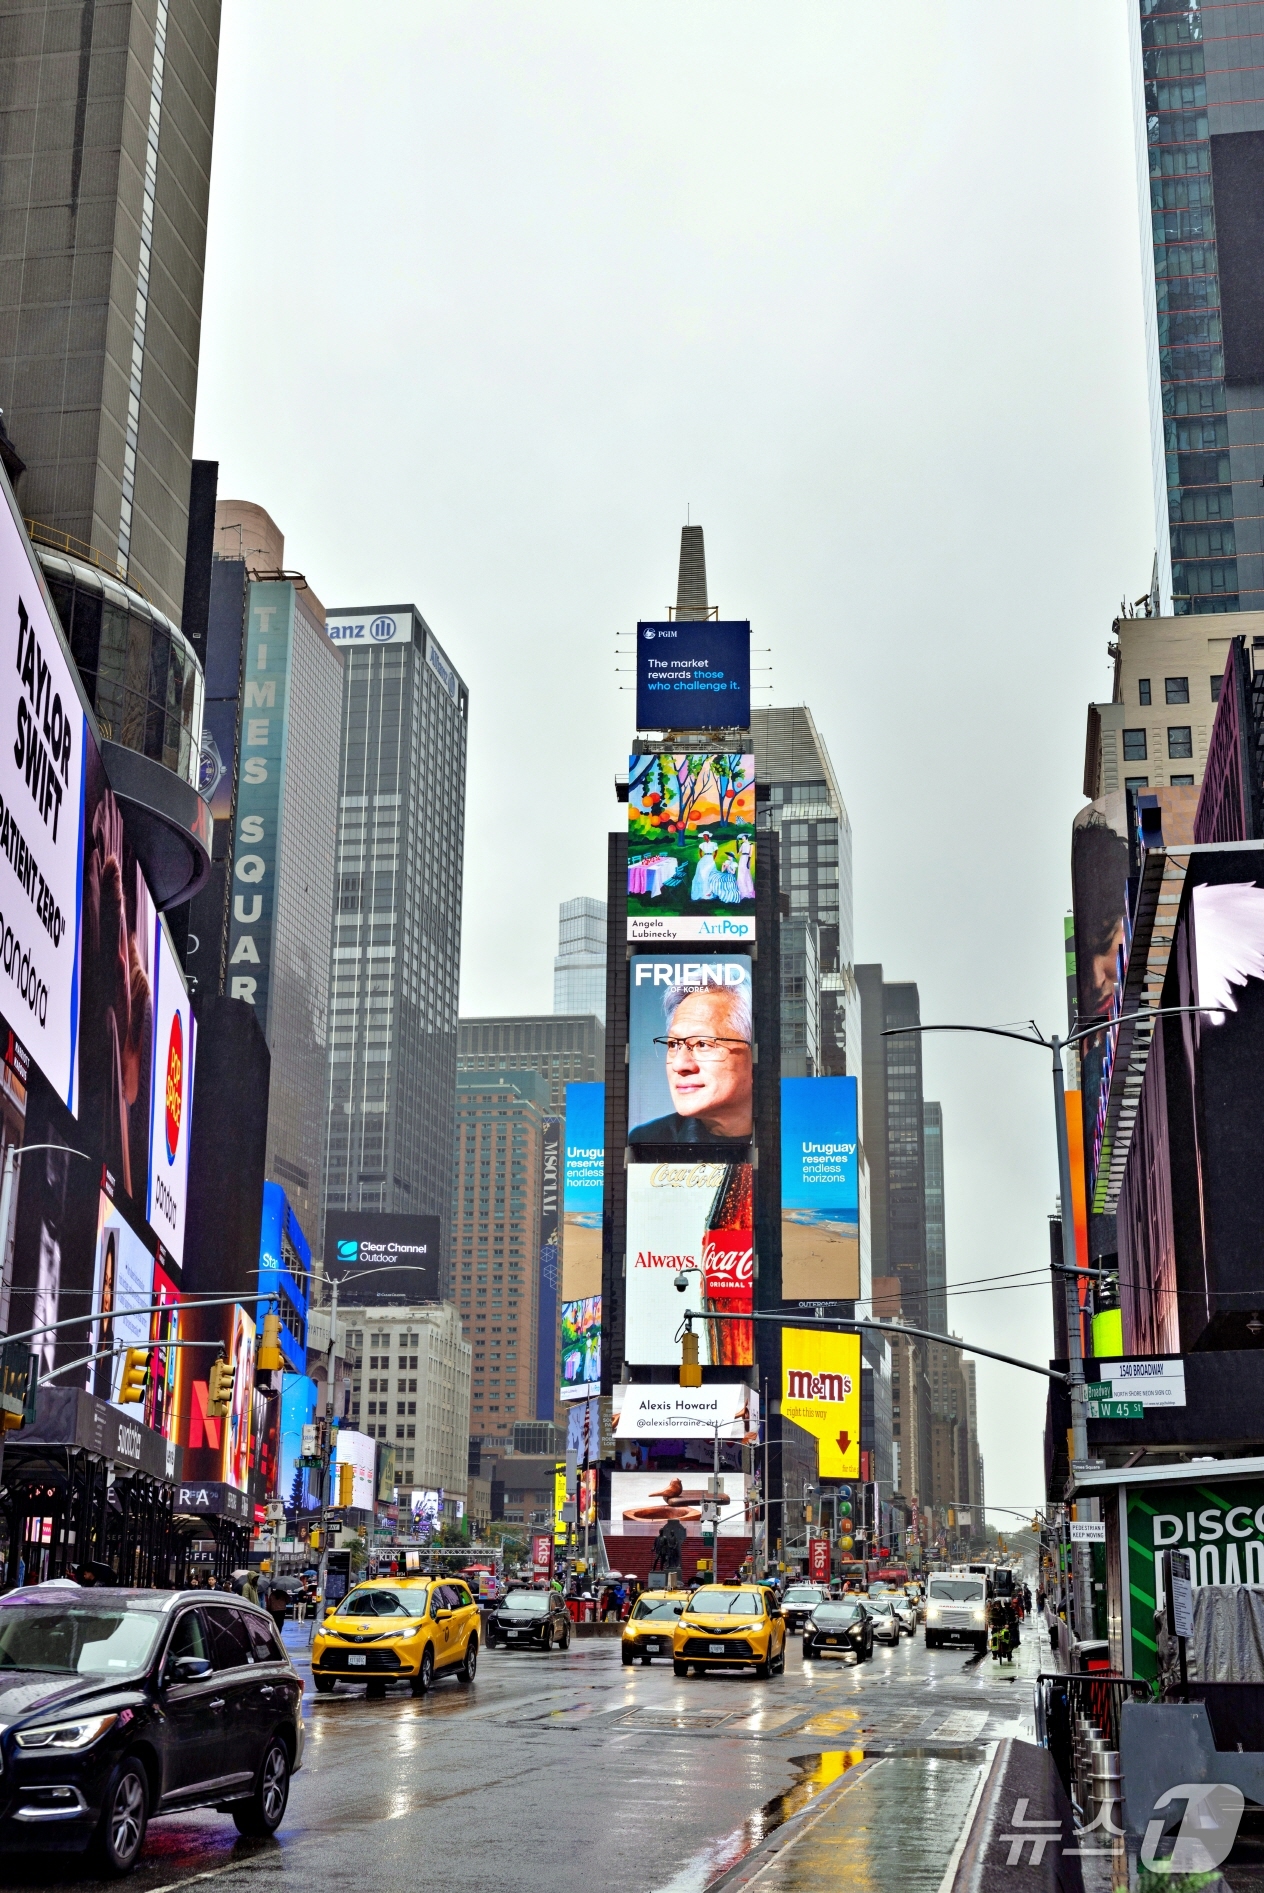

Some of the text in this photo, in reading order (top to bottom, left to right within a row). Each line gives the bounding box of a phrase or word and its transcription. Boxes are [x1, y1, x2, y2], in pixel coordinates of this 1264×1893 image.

[658, 630, 678, 638] PGIM
[648, 659, 709, 668] The market
[648, 670, 724, 679] rewards those
[16, 594, 72, 789] TAYLOR
[648, 681, 740, 692] who challenge it.
[243, 606, 276, 785] TIMES
[14, 695, 63, 845] SWIFT
[632, 919, 663, 929] Angela
[632, 930, 677, 940] Lubinecky
[635, 963, 745, 986] FRIEND
[171, 1047, 181, 1089] POP
[166, 1077, 181, 1128] SPACE
[802, 1142, 856, 1155] Uruguay
[802, 1155, 848, 1163] reserves
[567, 1168, 604, 1178] endless
[802, 1164, 841, 1173] endless
[802, 1173, 845, 1183] horizons
[360, 1241, 427, 1254] Clear Channel
[262, 1252, 278, 1269] Sta
[360, 1252, 398, 1263] Outdoor
[634, 1251, 698, 1271] Always.
[1120, 1363, 1164, 1377] 1540 BROADWAY
[1088, 1385, 1111, 1398] Broadway
[639, 1400, 718, 1411] Alexis Howard
[1101, 1403, 1141, 1416] W 45 St
[787, 1408, 827, 1420] right this way
[538, 1537, 551, 1564] tkts
[814, 1541, 828, 1568] tkts
